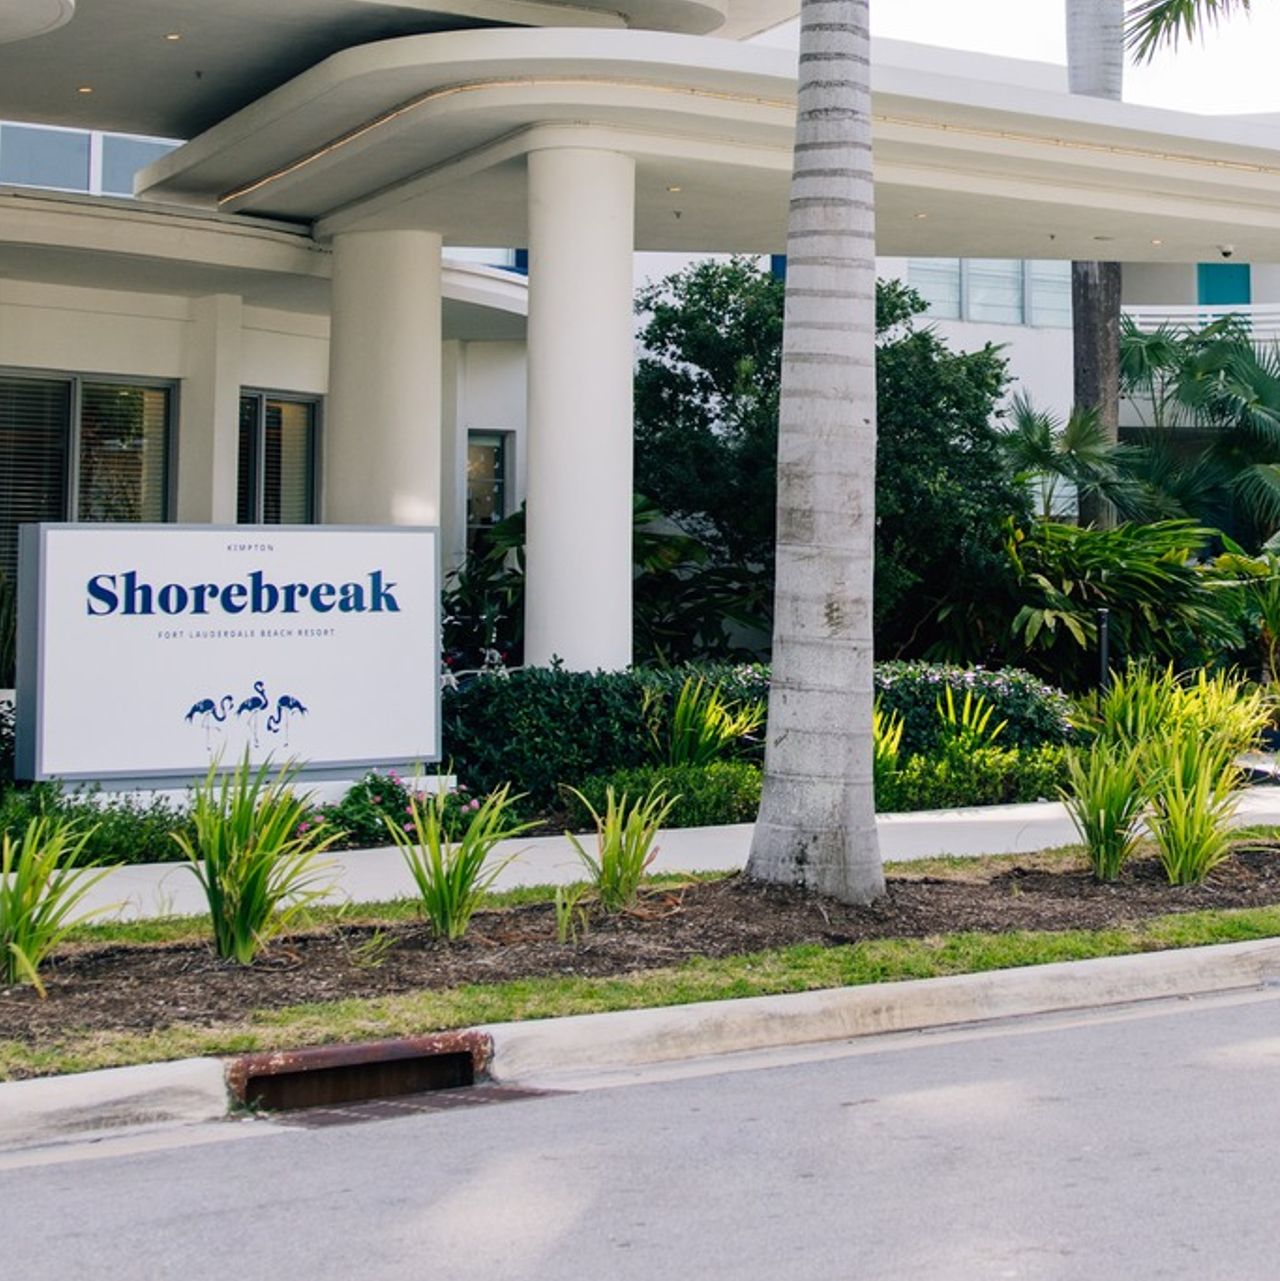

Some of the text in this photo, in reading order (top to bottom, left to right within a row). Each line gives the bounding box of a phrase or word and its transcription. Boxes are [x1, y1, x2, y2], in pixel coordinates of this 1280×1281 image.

[226, 543, 275, 552] KIMPTON
[86, 569, 401, 616] Shorebreak
[157, 627, 336, 640] FORT LAUDERDALE BEACH RESORT
